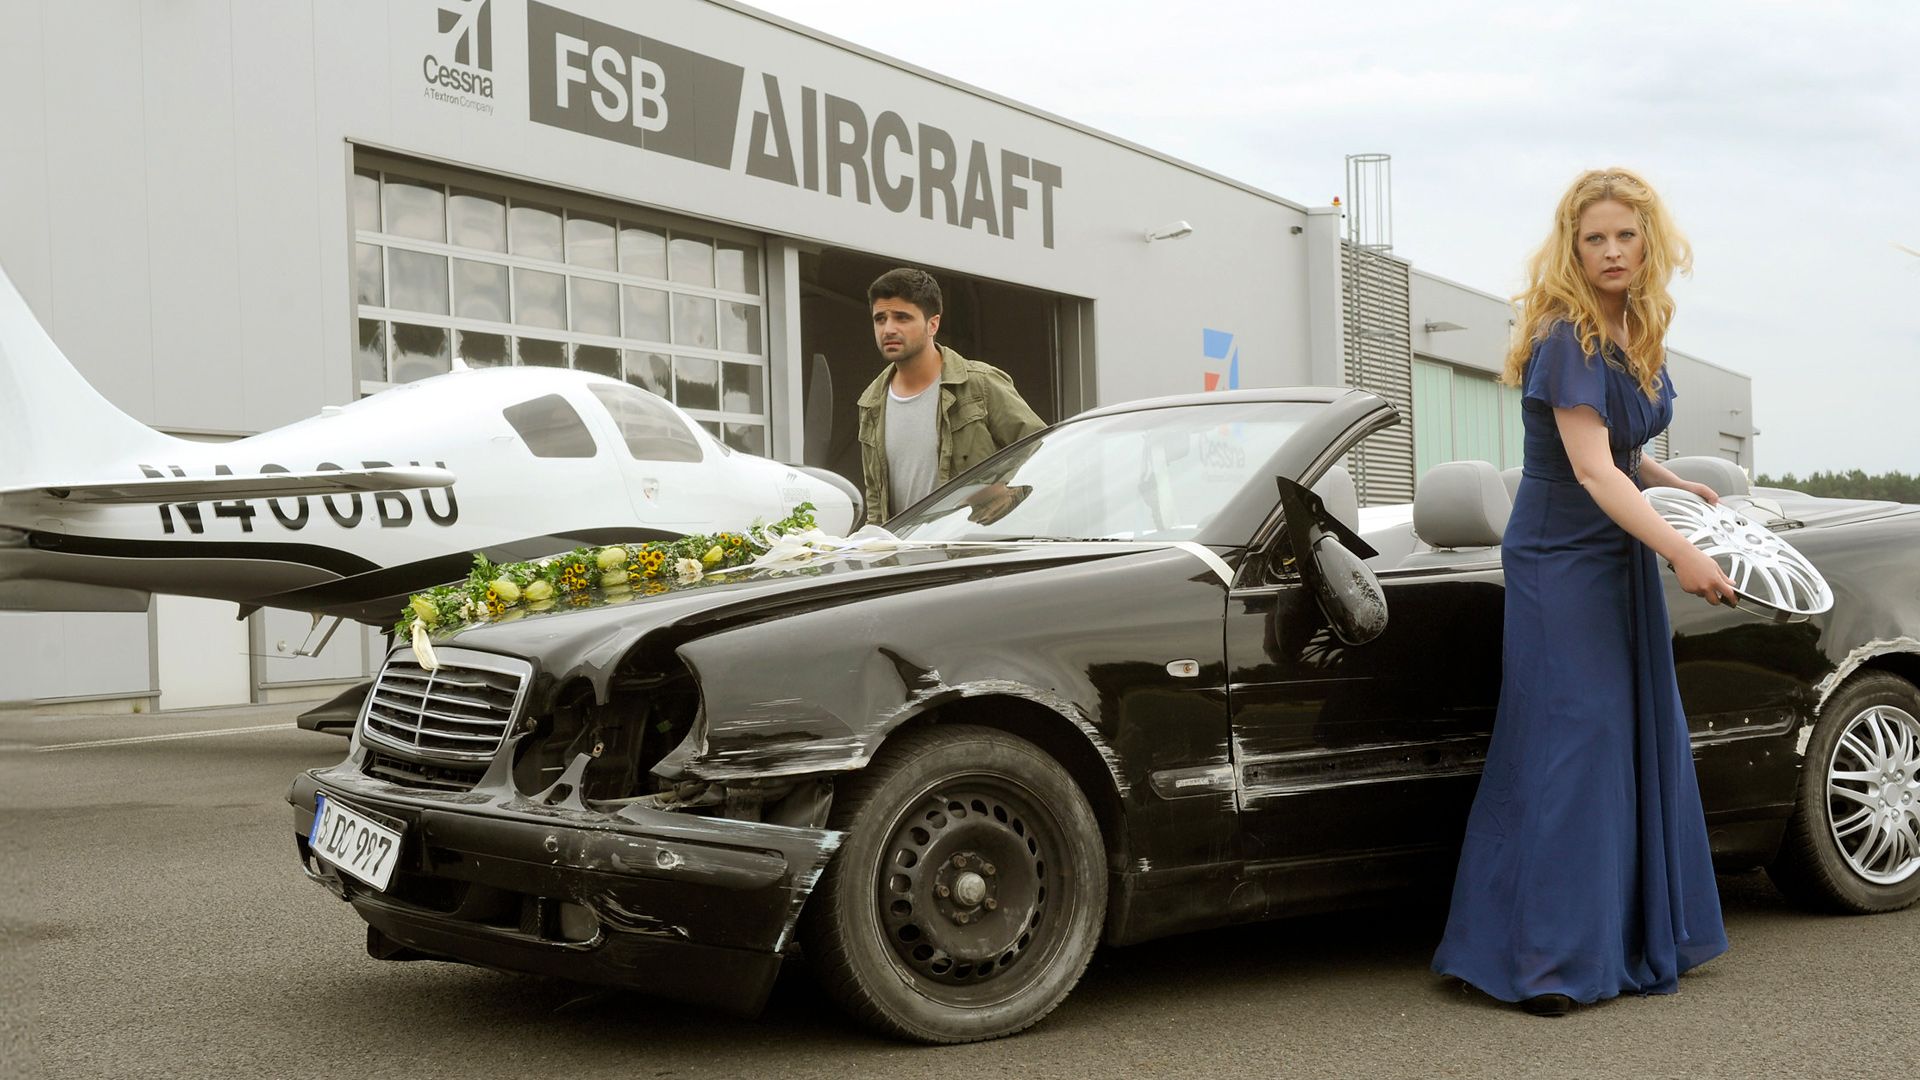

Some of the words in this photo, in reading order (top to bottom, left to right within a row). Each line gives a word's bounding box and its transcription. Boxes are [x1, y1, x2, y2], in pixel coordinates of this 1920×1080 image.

[423, 54, 494, 99] Cessna
[424, 87, 430, 99] A
[430, 87, 459, 105] Textron
[460, 95, 494, 116] Company
[555, 32, 669, 133] FSB
[745, 72, 1063, 250] AIRCRAFT
